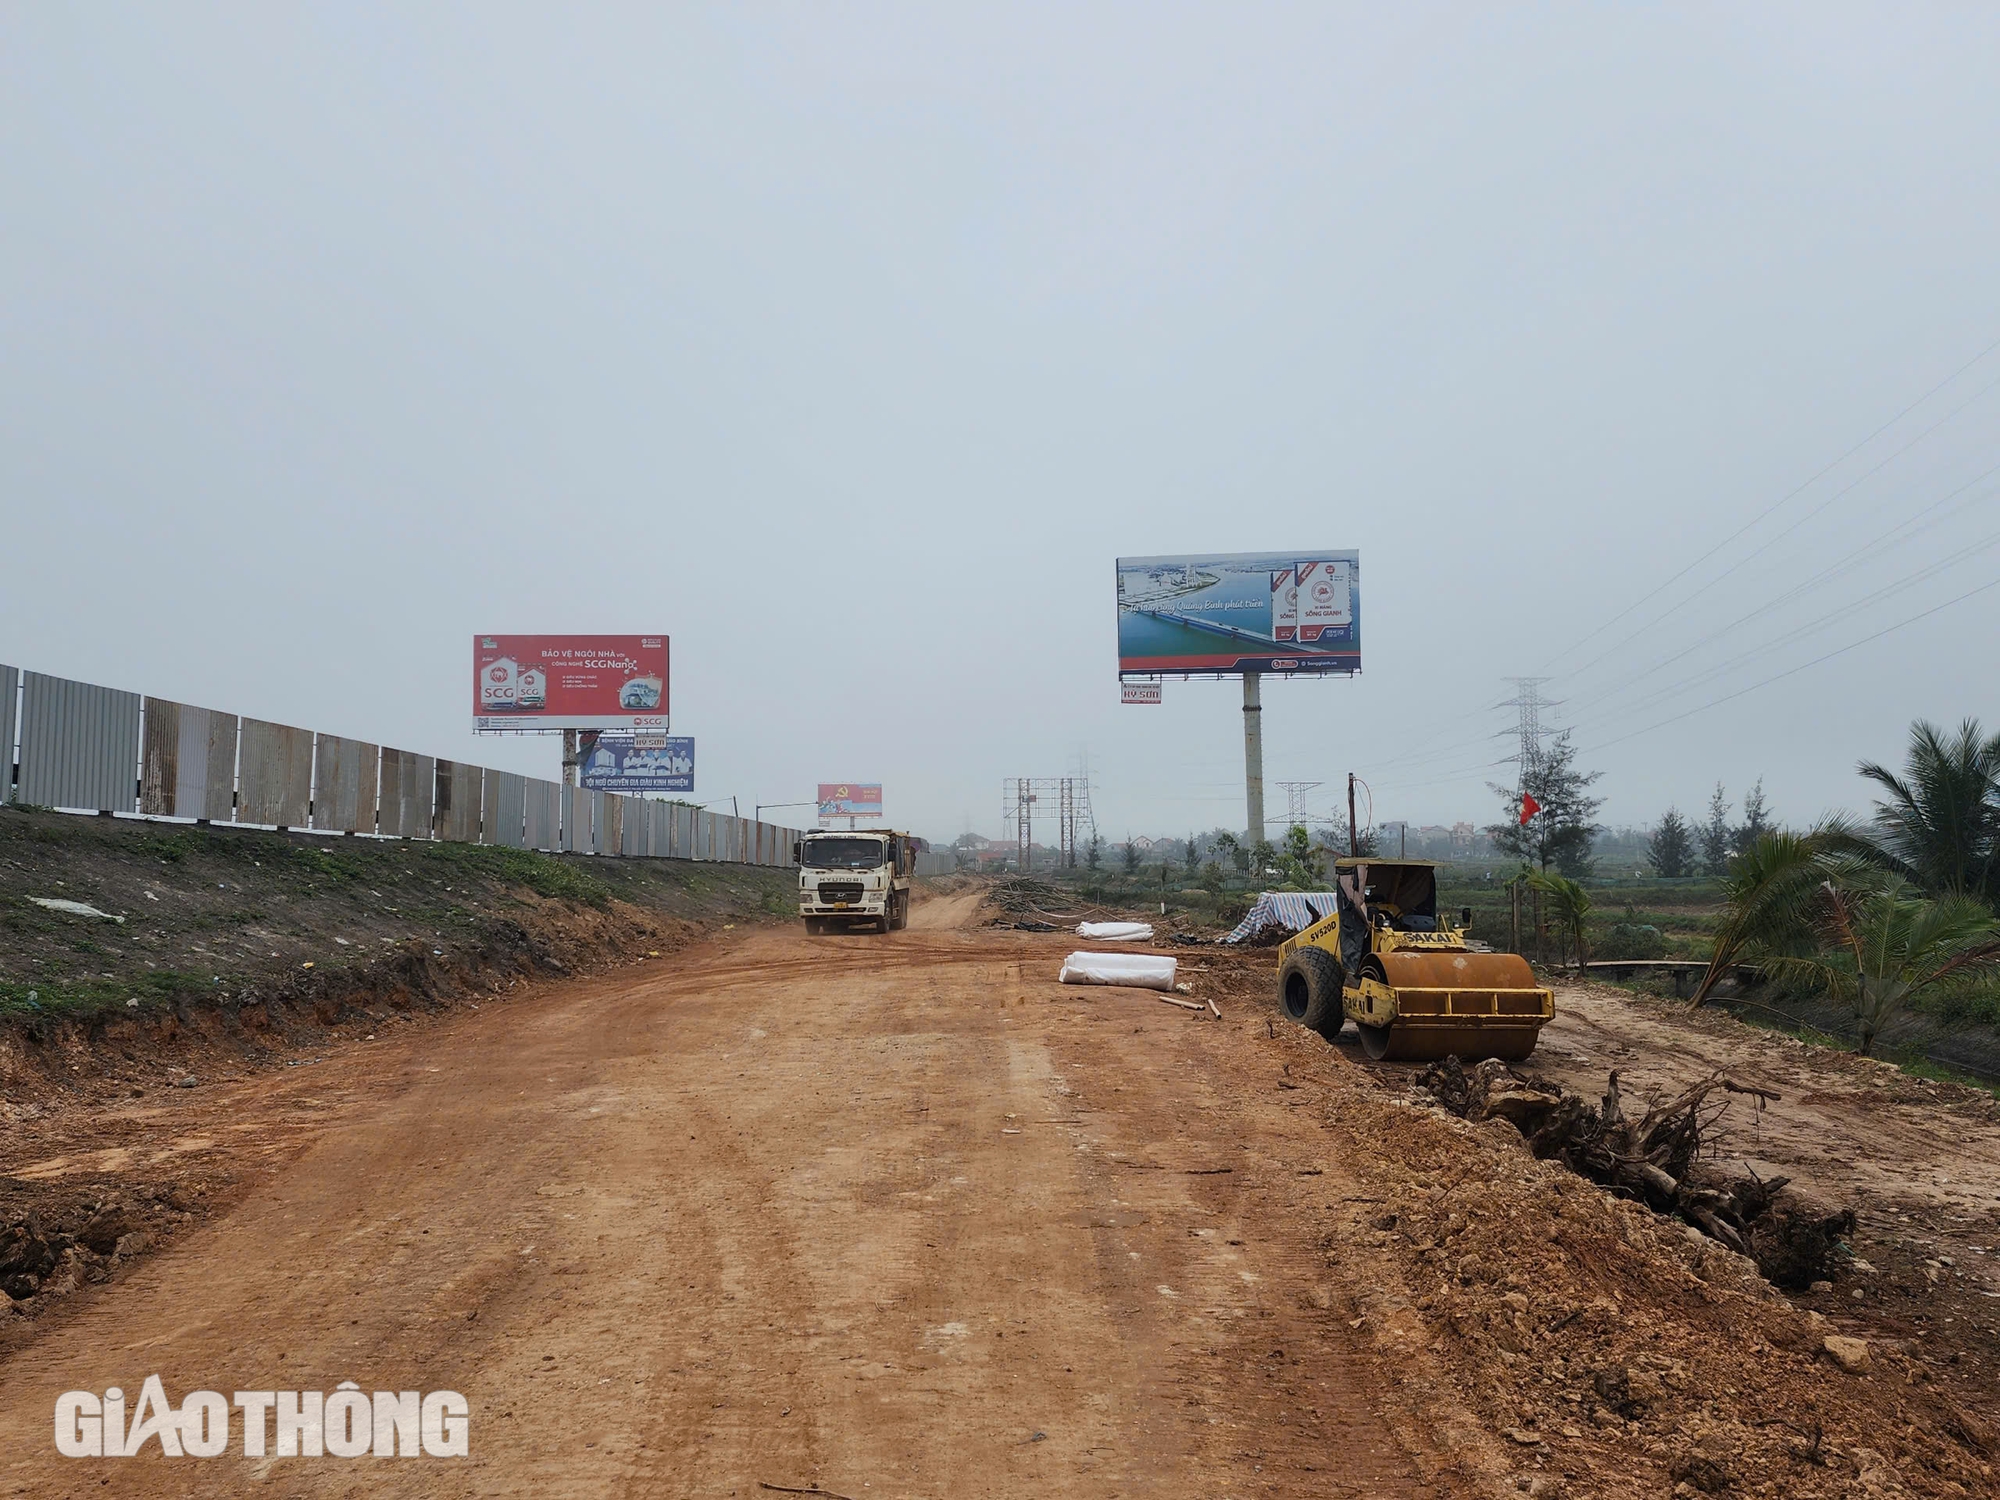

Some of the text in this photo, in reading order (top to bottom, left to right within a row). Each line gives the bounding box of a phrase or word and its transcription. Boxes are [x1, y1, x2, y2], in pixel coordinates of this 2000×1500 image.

[541, 648, 560, 657] BẢO
[561, 648, 573, 659] VỆ
[574, 648, 596, 657] NGÔI
[597, 648, 615, 657] NHÀ
[485, 688, 514, 698] SCG
[521, 688, 539, 696] SCG
[643, 717, 662, 725] SCG
[1310, 920, 1337, 943] SV520D
[1403, 932, 1452, 943] SAKAI
